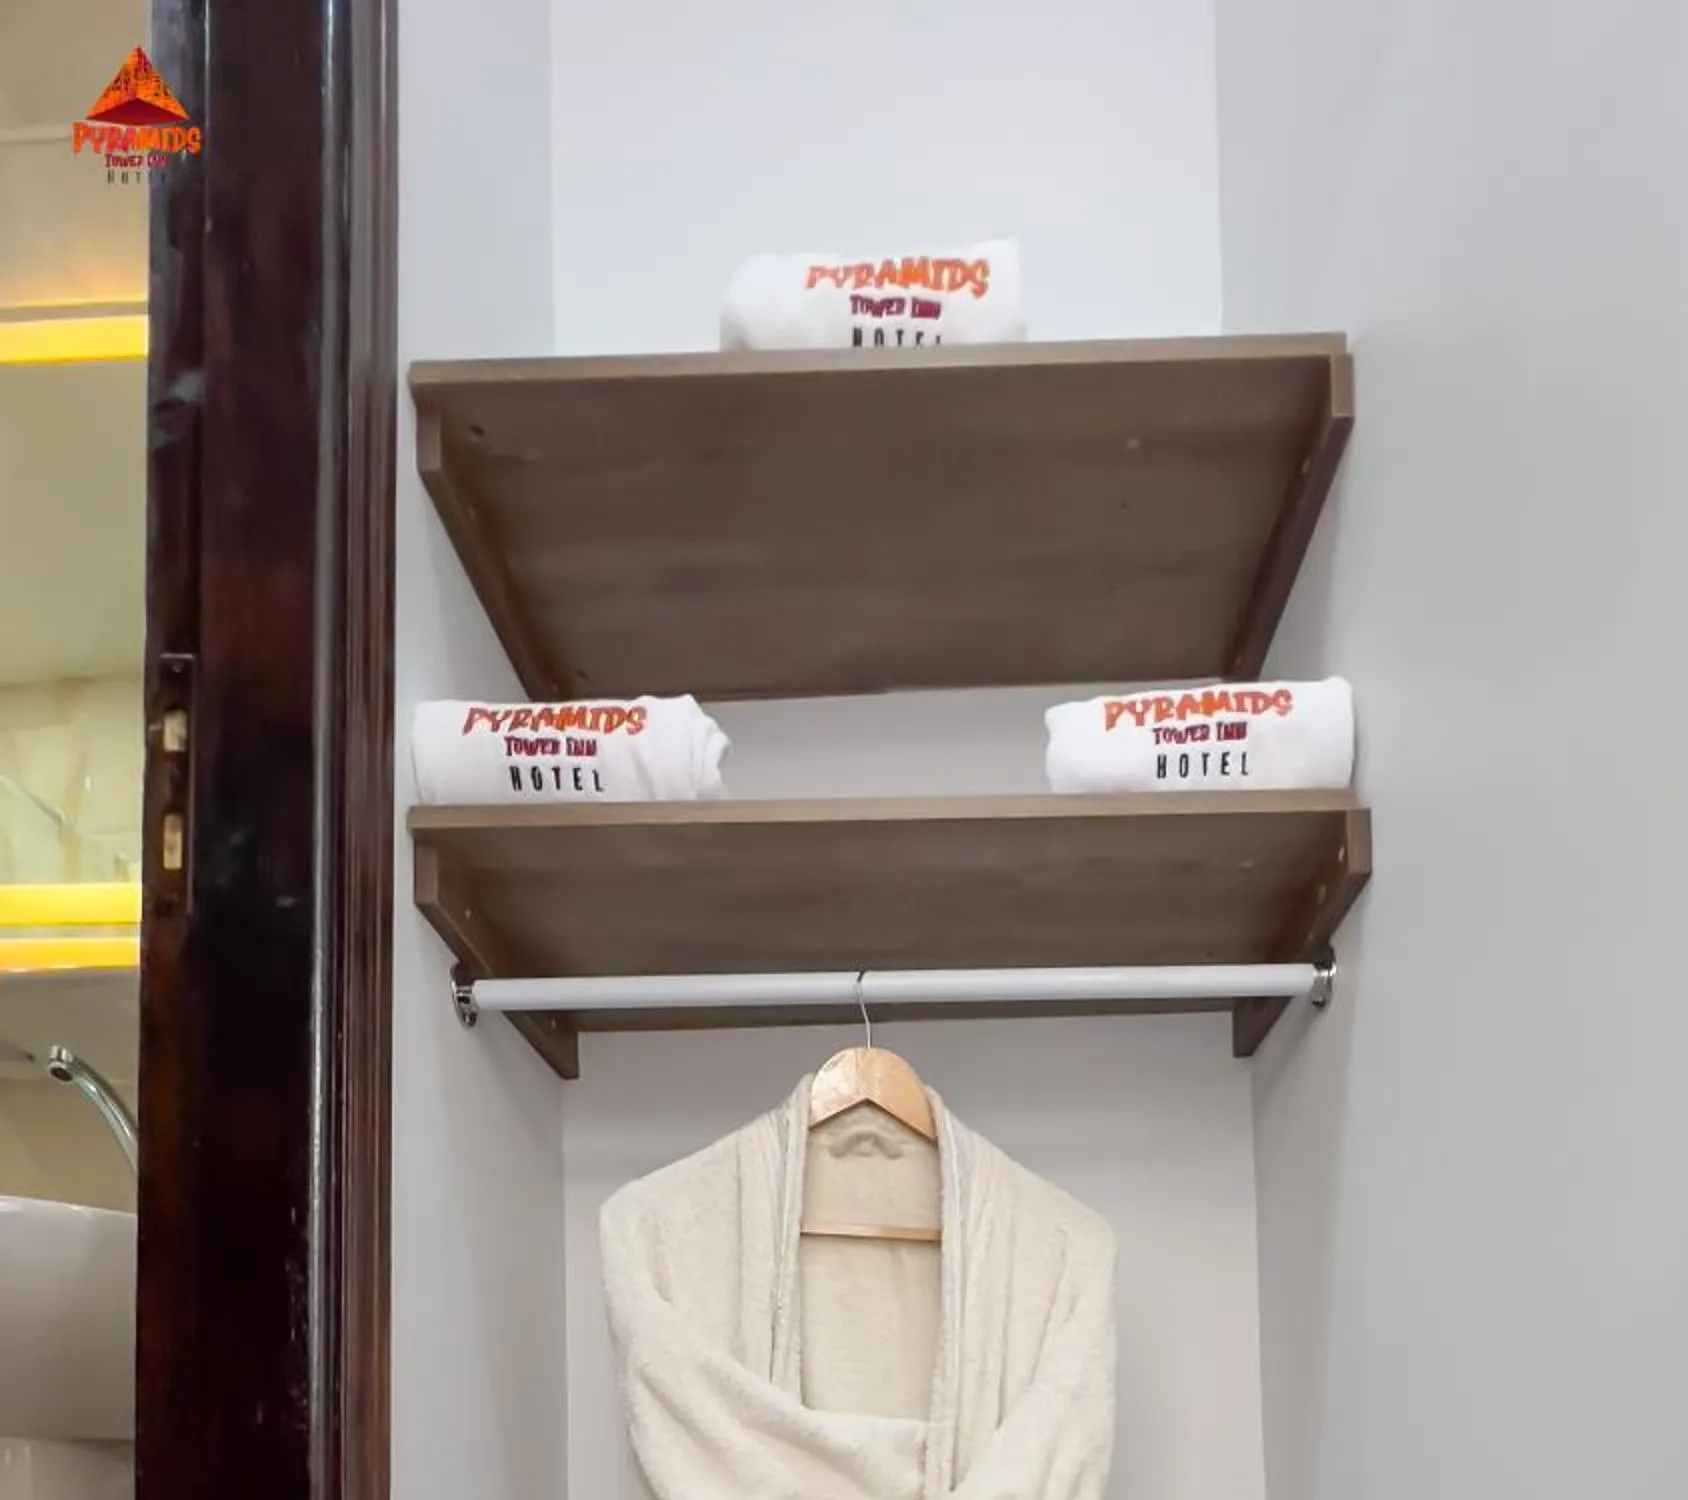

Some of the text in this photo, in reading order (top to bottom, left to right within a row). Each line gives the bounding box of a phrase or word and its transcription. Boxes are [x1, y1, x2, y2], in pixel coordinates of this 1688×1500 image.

[805, 256, 989, 298] PYRAMIDS
[462, 704, 647, 736] PYRAMIDS
[1104, 688, 1293, 732] PYRAMIDS
[504, 735, 560, 757] TOWER
[1153, 724, 1210, 745] TOWER
[509, 765, 604, 792] HOTEL
[1157, 751, 1249, 779] HOTEL
